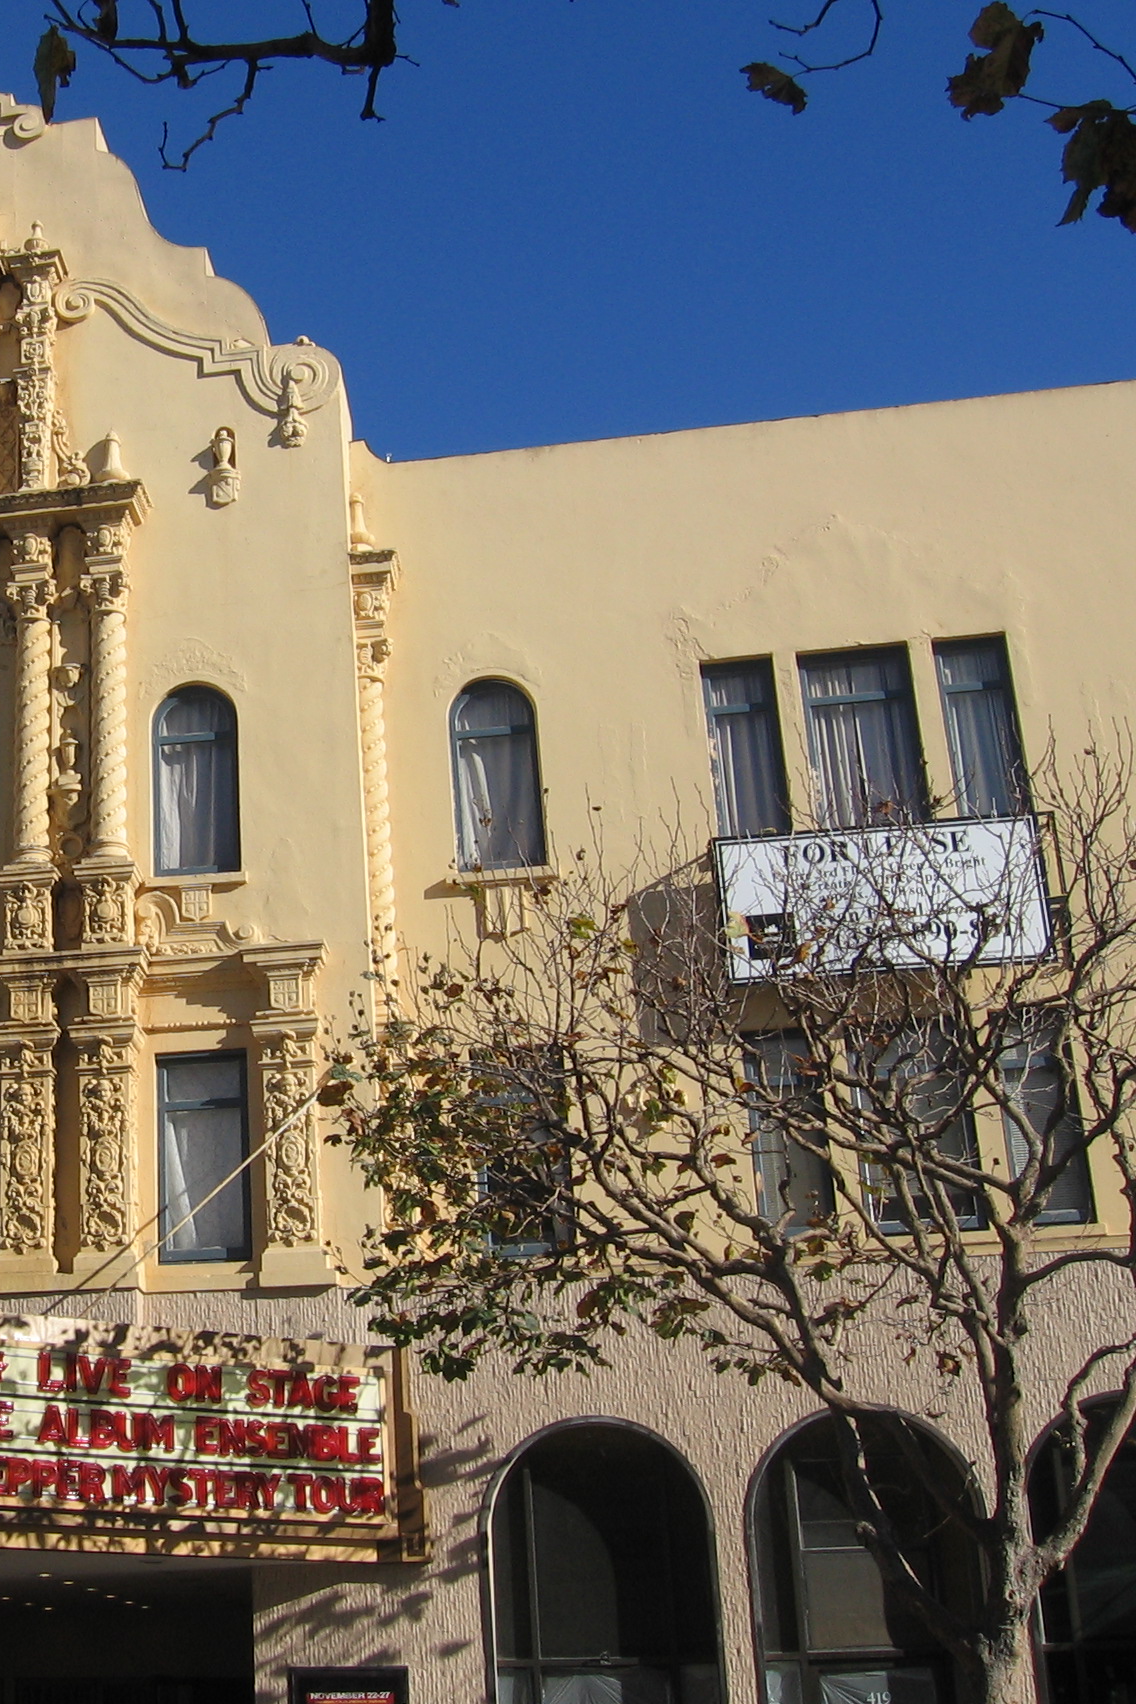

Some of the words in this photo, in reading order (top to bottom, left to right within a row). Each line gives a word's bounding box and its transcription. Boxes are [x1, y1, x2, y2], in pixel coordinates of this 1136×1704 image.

[36, 1351, 132, 1399] LIVE
[167, 1363, 223, 1404] ON
[246, 1370, 361, 1414] STAGE
[36, 1404, 175, 1452] ALBUM
[195, 1416, 382, 1465] ENSEMBLE
[112, 1463, 282, 1512] MYSTERY
[287, 1474, 385, 1516] TOUR
[309, 1691, 365, 1700] NOVEMBER
[866, 1691, 892, 1704] 419
